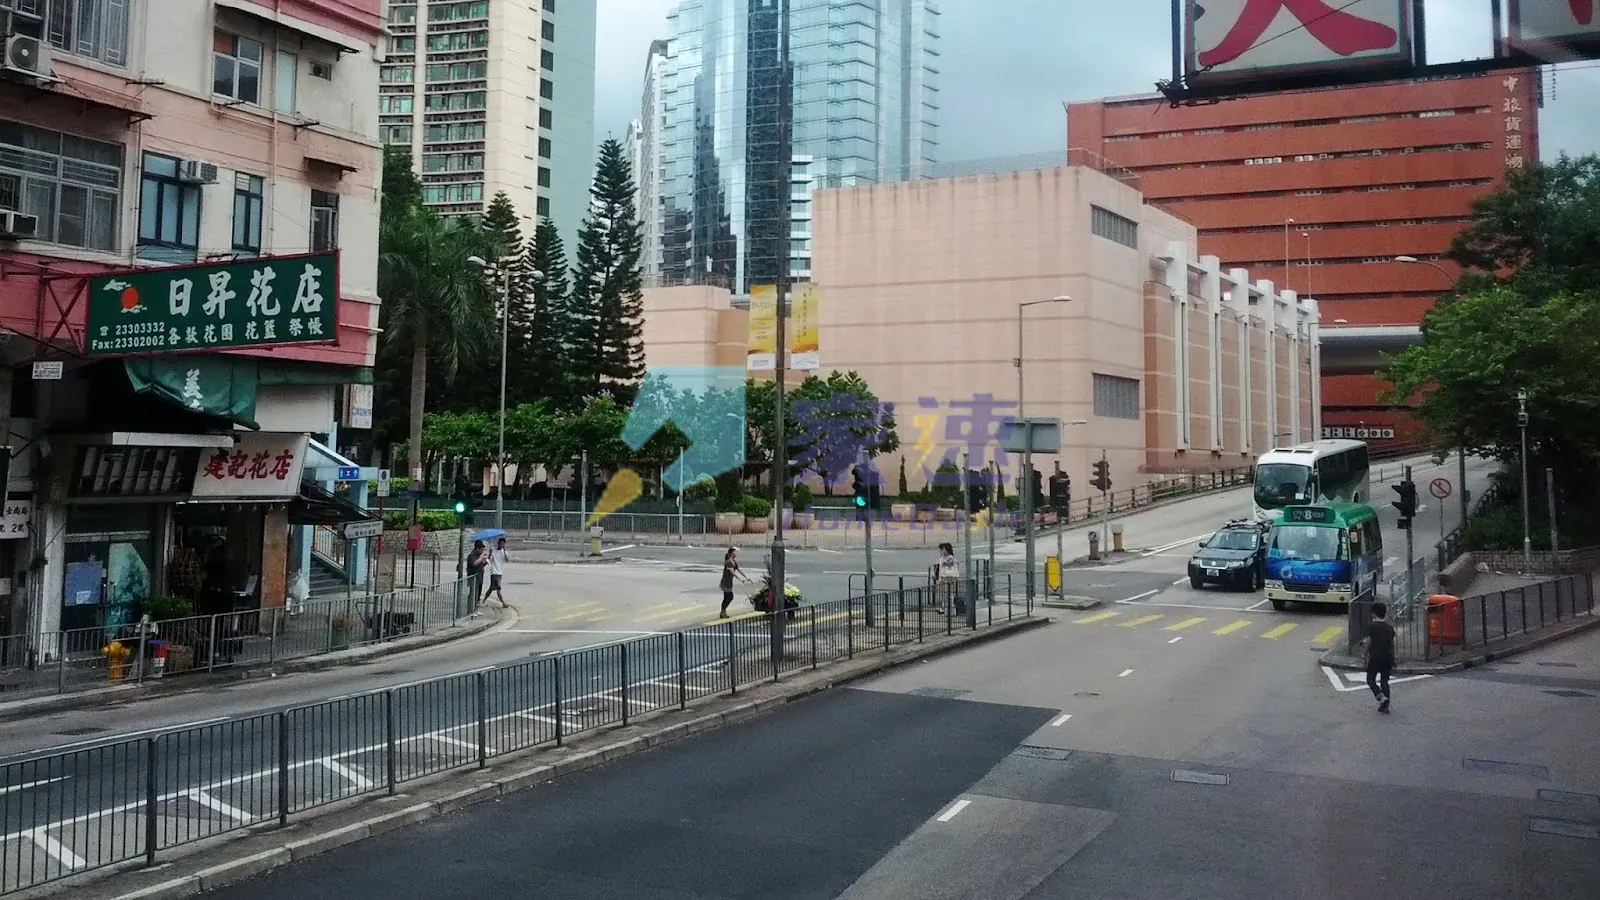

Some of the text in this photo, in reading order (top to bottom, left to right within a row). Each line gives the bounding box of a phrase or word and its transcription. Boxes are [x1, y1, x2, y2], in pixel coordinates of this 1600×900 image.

[169, 263, 324, 320] 日昇花店
[115, 321, 165, 336] 23303332
[244, 319, 277, 341] 花籃
[1304, 510, 1312, 520] 8
